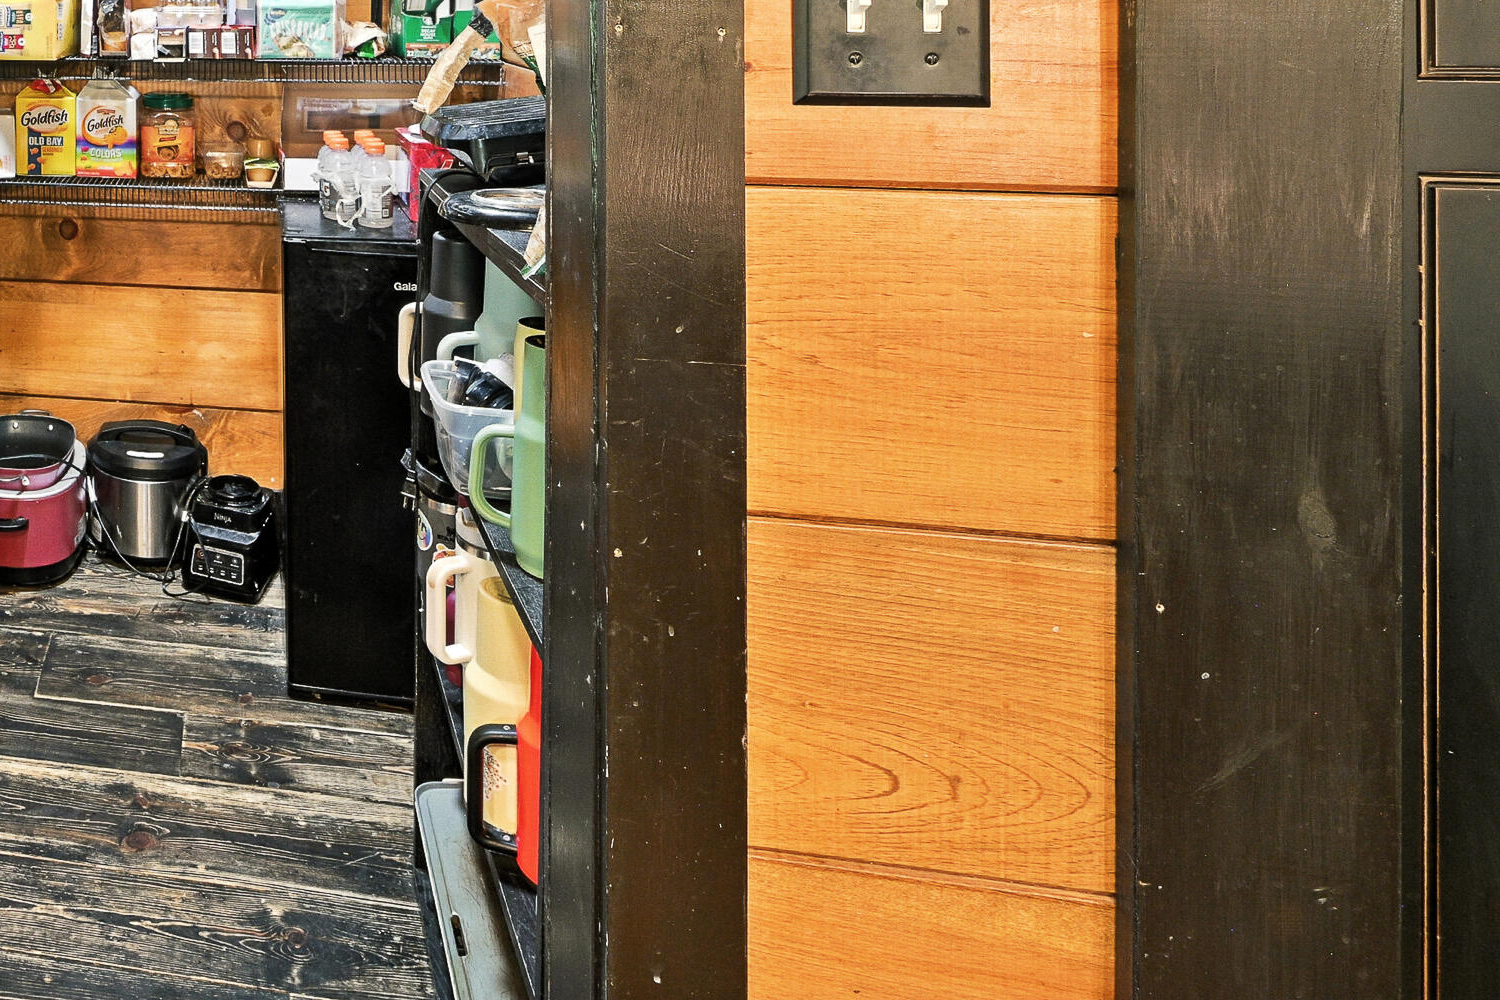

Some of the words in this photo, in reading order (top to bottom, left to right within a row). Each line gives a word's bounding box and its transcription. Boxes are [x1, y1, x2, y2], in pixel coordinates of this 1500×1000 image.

[21, 109, 68, 127] Goldfish
[87, 114, 124, 132] Goldfish
[28, 136, 44, 146] OLD
[90, 148, 122, 158] COLORS
[394, 282, 417, 291] Gala
[213, 512, 232, 524] NINJA
